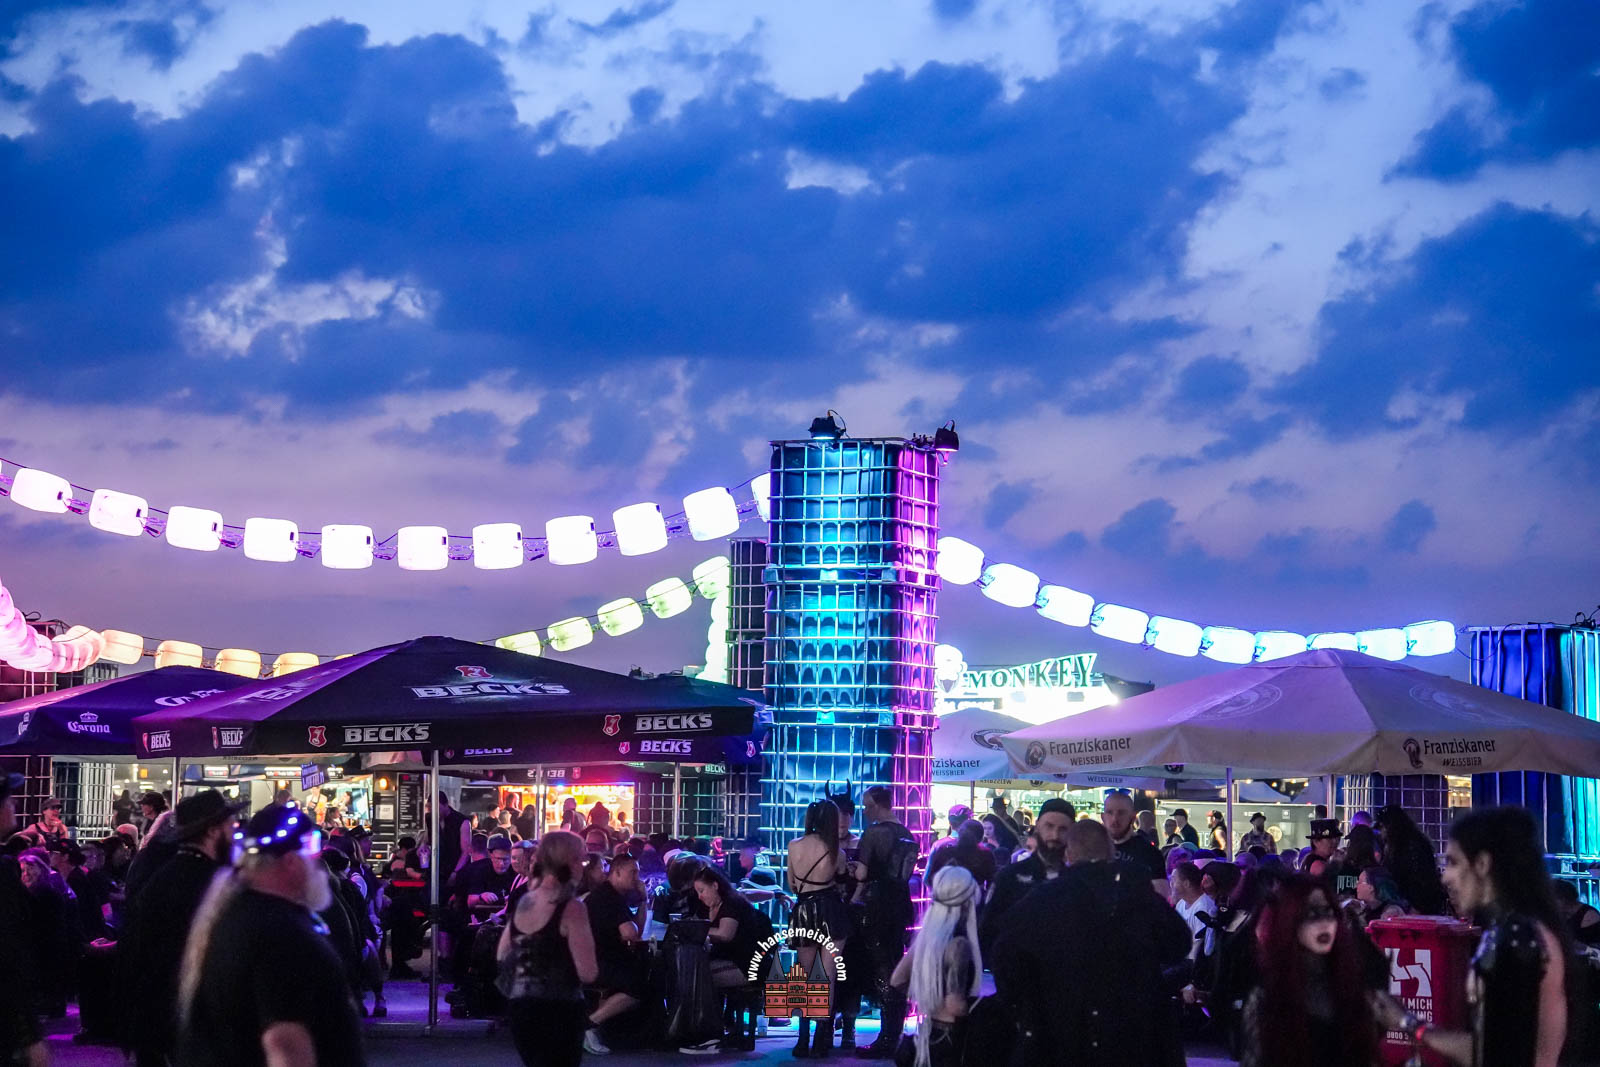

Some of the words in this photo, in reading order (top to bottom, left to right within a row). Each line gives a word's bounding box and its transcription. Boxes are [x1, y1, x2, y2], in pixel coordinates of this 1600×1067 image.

[967, 653, 1097, 688] MONKEY
[411, 682, 571, 698] BECK'S
[67, 721, 111, 734] Corona
[636, 712, 713, 731] BECK'S
[344, 723, 430, 743] BECK'S
[639, 739, 692, 753] BECK'S
[1048, 736, 1132, 756] Franziskaner
[1423, 738, 1496, 755] Franziskaner
[931, 758, 981, 768] nziskaner
[1070, 754, 1113, 766] WEISSBIER
